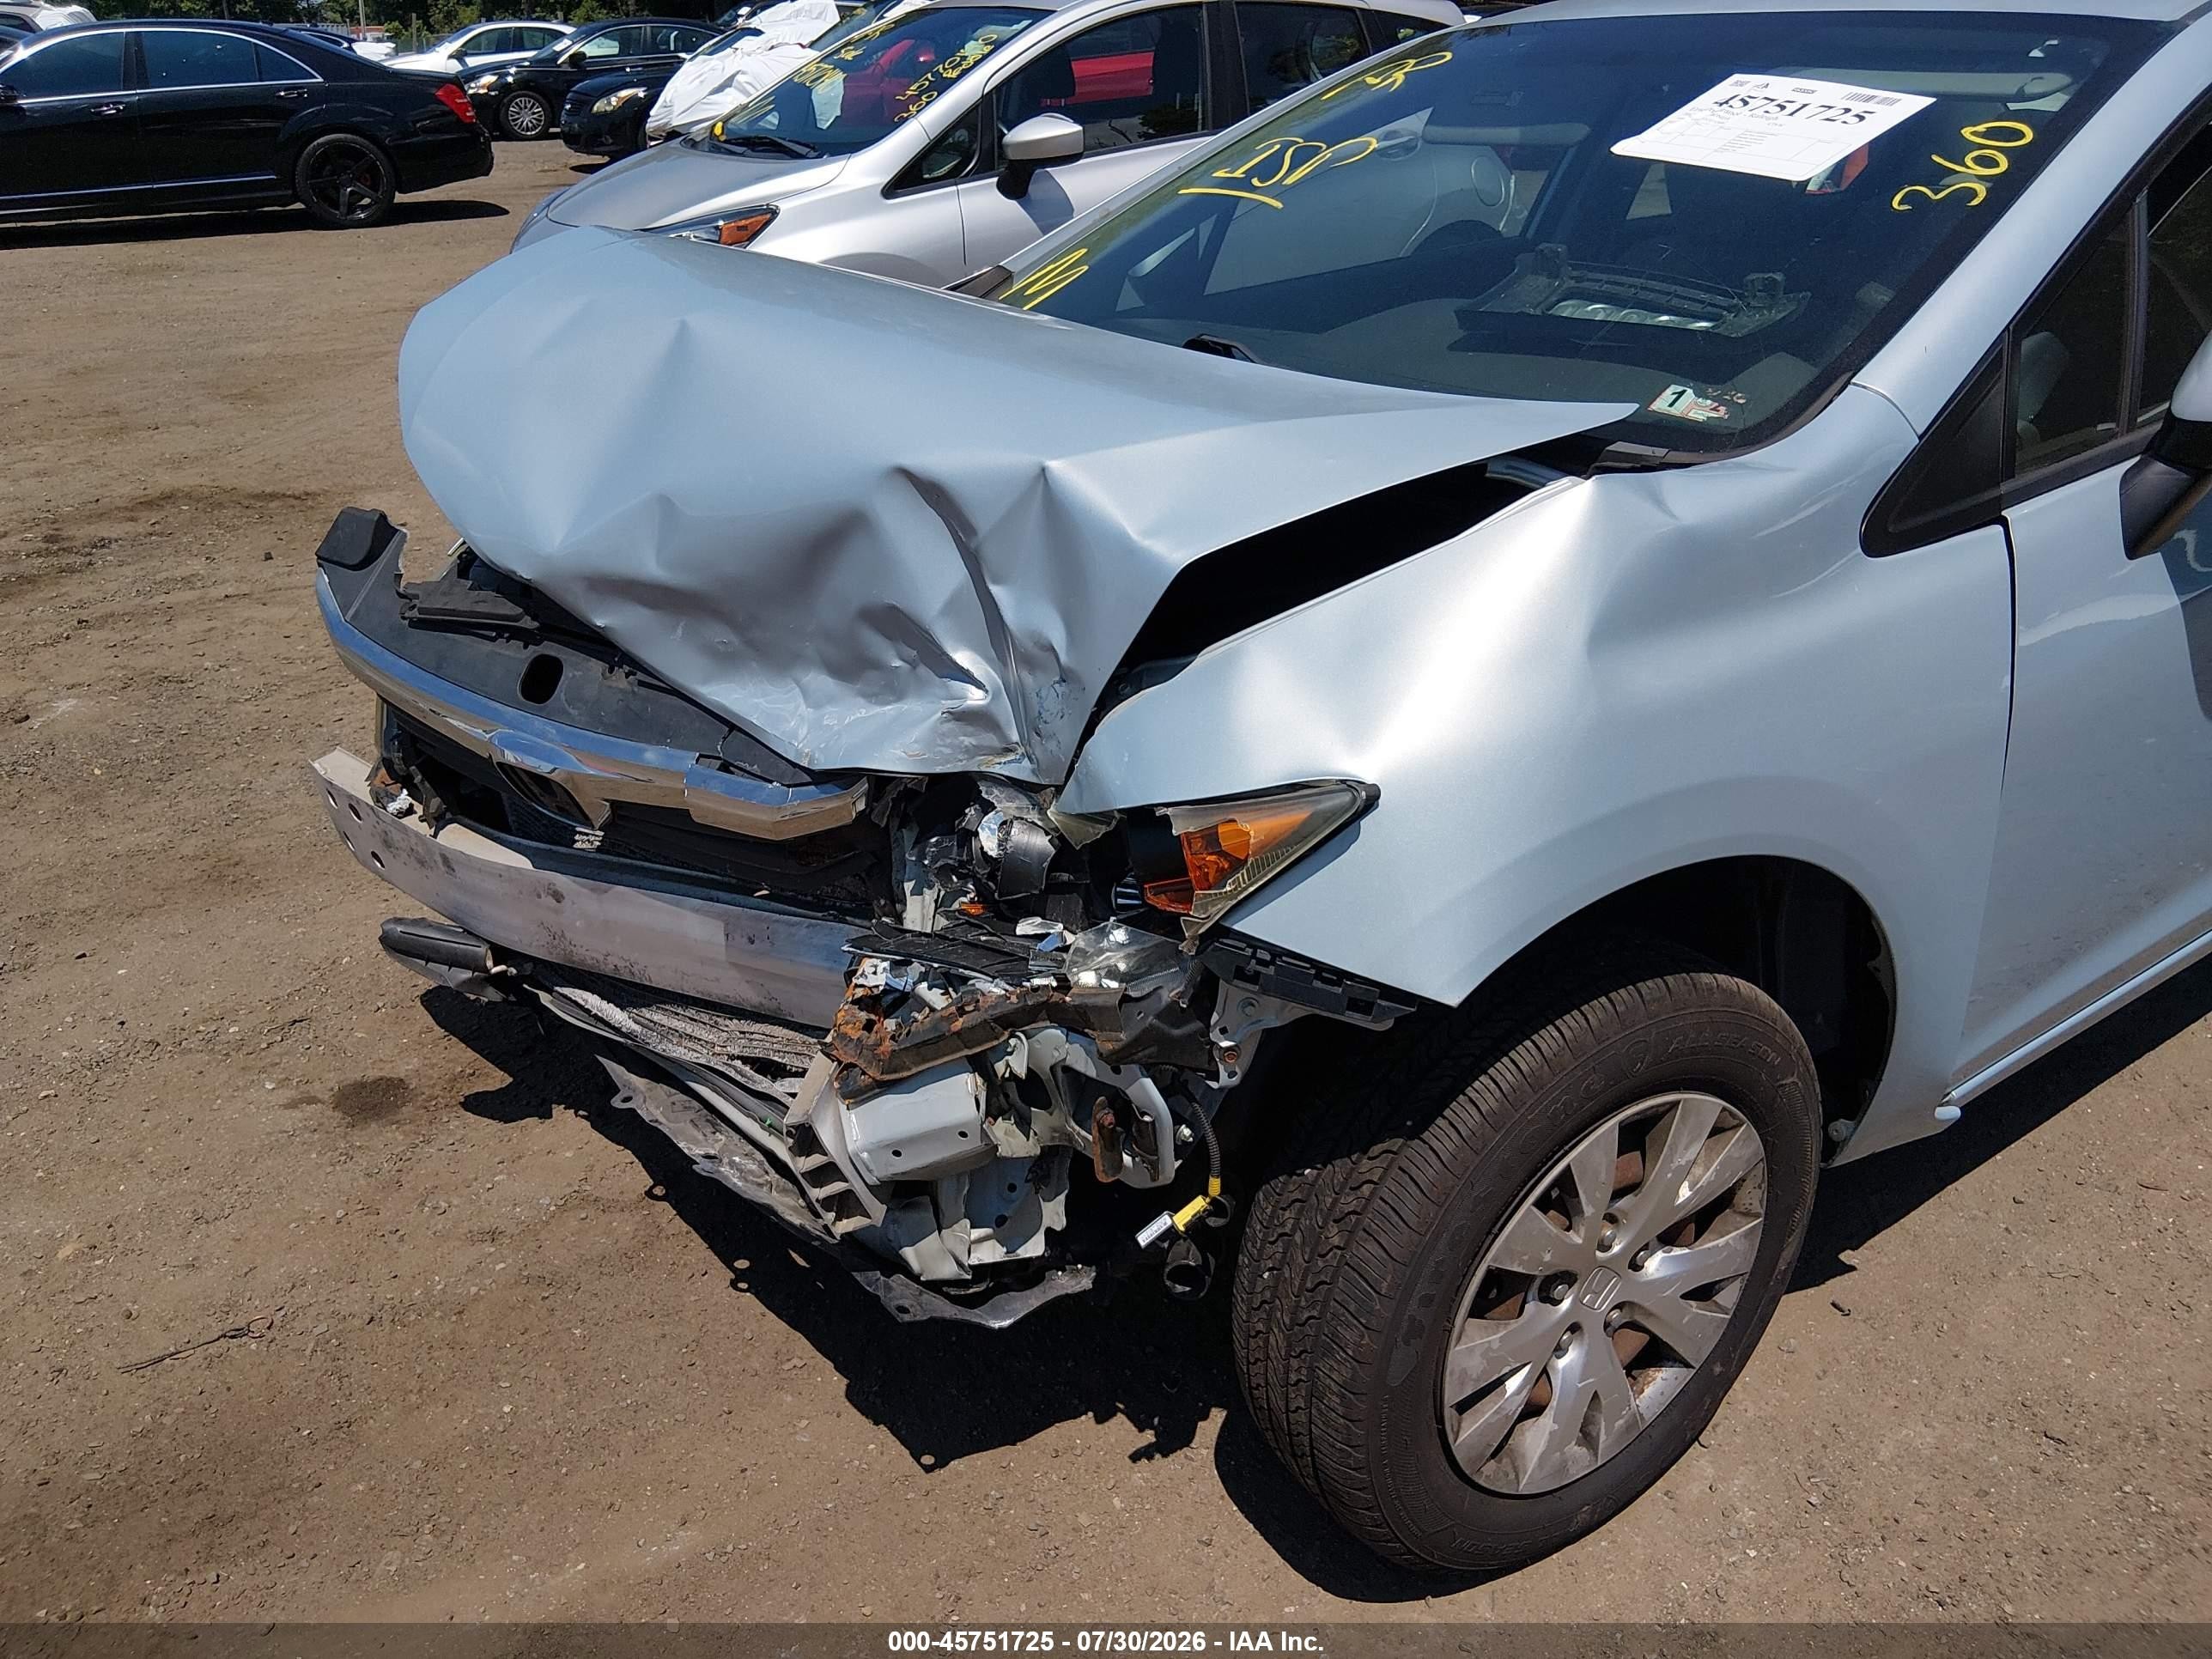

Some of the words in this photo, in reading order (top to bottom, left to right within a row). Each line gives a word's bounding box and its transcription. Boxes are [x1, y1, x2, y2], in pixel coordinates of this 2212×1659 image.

[894, 91, 939, 122] 360
[1712, 94, 1877, 125] 45751725
[1891, 120, 2034, 211] 360
[1667, 389, 1688, 408] 1
